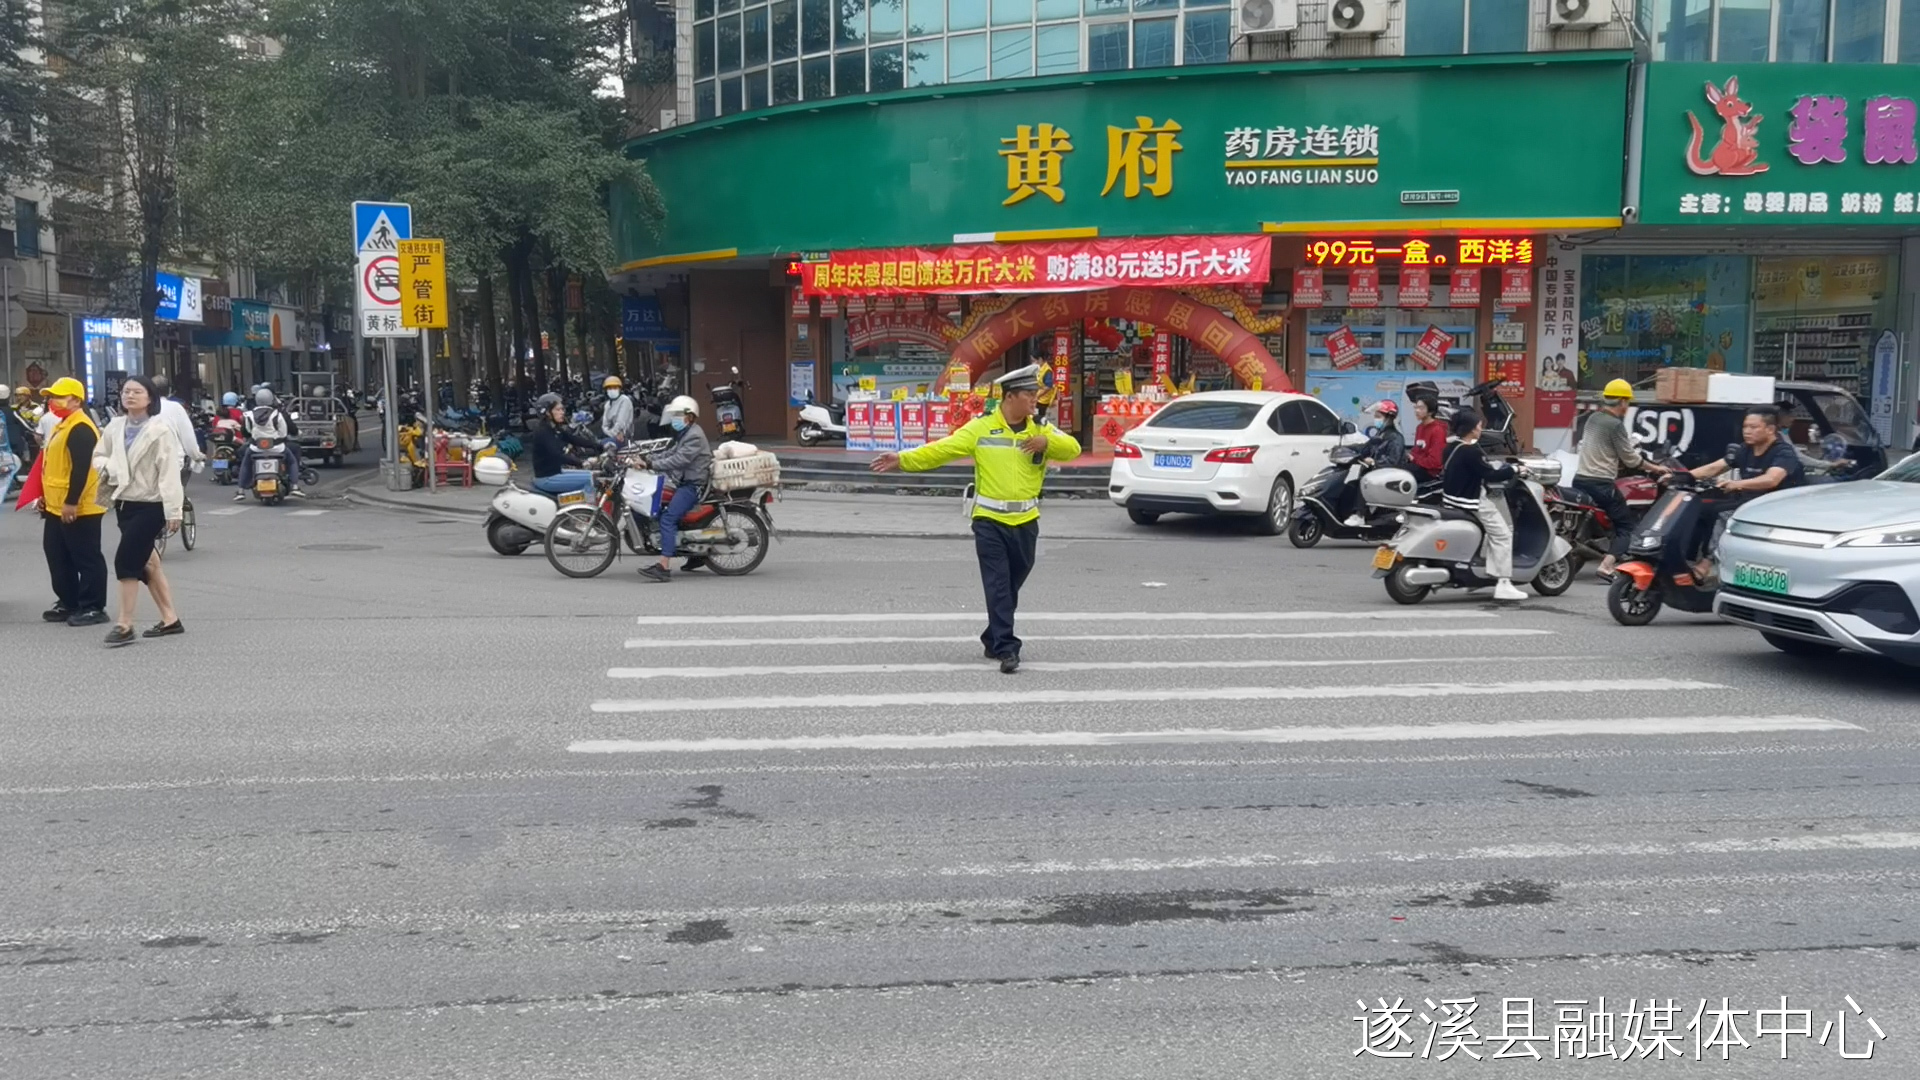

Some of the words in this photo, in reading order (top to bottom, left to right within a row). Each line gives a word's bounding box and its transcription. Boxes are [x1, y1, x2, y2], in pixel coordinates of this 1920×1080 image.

[1224, 124, 1379, 158] 药房连锁
[1786, 93, 1919, 165] 袋鼠
[998, 116, 1184, 205] 黄府
[1225, 170, 1257, 185] YAO
[1260, 169, 1303, 185] FANG
[1305, 169, 1342, 184] LIAN
[1345, 169, 1379, 184] SUO
[1743, 191, 1829, 214] 母婴用品
[1840, 192, 1883, 214] 奶粉
[1893, 192, 1920, 214] 纸
[813, 255, 1036, 289] 周年庆感恩回馈送万斤大米
[1046, 247, 1252, 282] 购满88元送5斤大米
[1307, 239, 1533, 265] 99元一盒。西洋参
[412, 255, 435, 324] 严管街
[627, 308, 663, 323] 万达
[1544, 256, 1558, 336] 中国专利配方
[1561, 269, 1575, 349] 宝宝超凡守护
[943, 288, 1268, 386] 府大药房感恩回馈
[1055, 337, 1068, 397] 购满88元送5
